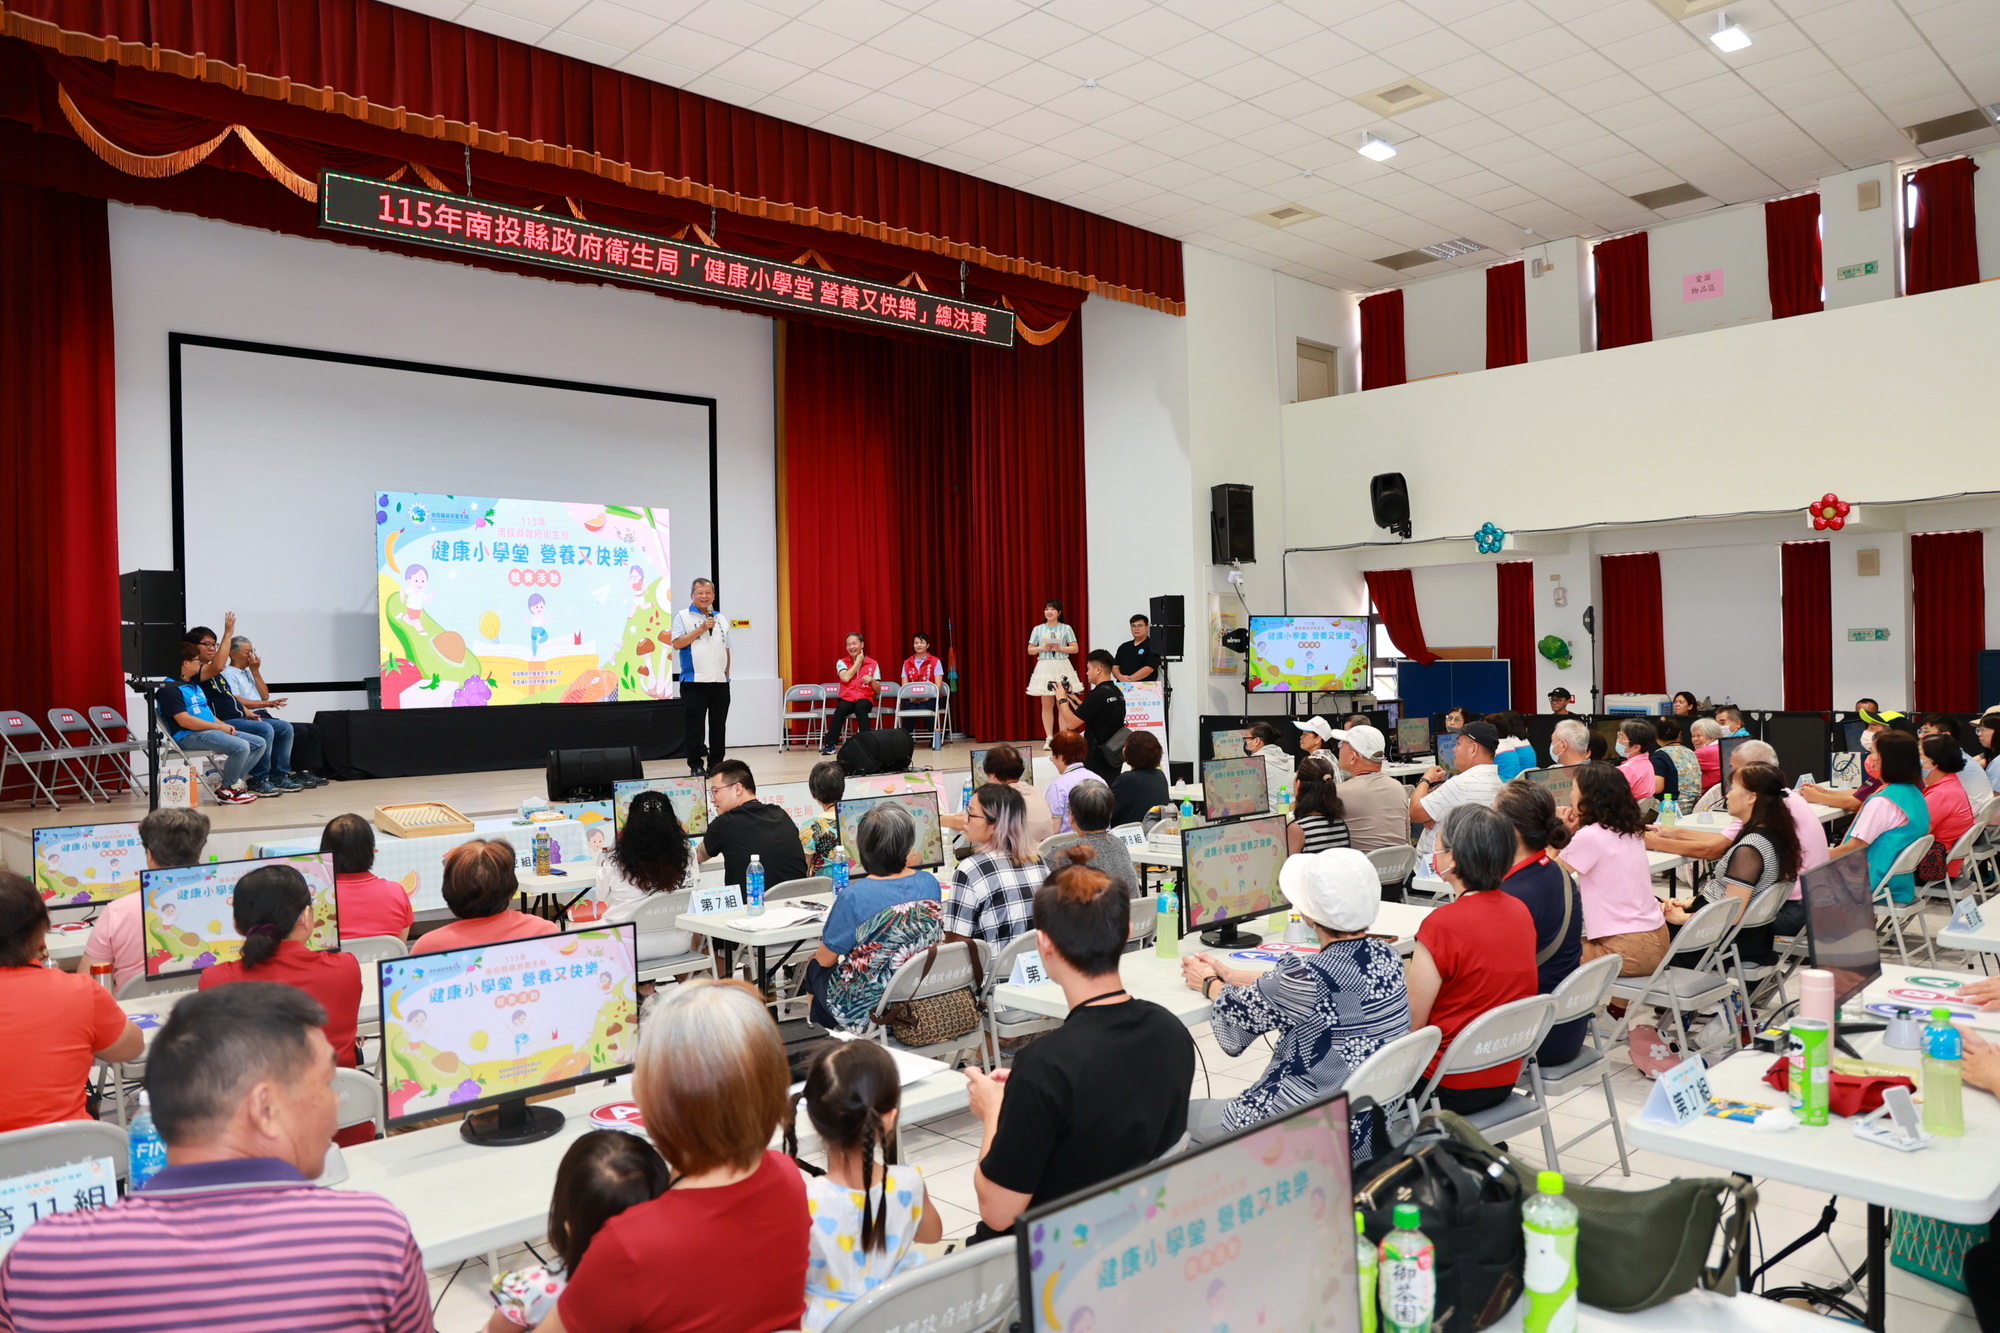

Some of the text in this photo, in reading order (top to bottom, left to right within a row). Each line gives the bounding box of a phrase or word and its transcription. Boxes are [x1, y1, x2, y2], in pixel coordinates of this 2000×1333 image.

[521, 516, 546, 527] 115年
[431, 538, 629, 567] 健康小學堂 營養又快樂
[700, 894, 738, 912] 第7組
[429, 960, 599, 1004] 健康小學堂 營養又快樂
[1900, 990, 1938, 999] B
[609, 1105, 641, 1120] A
